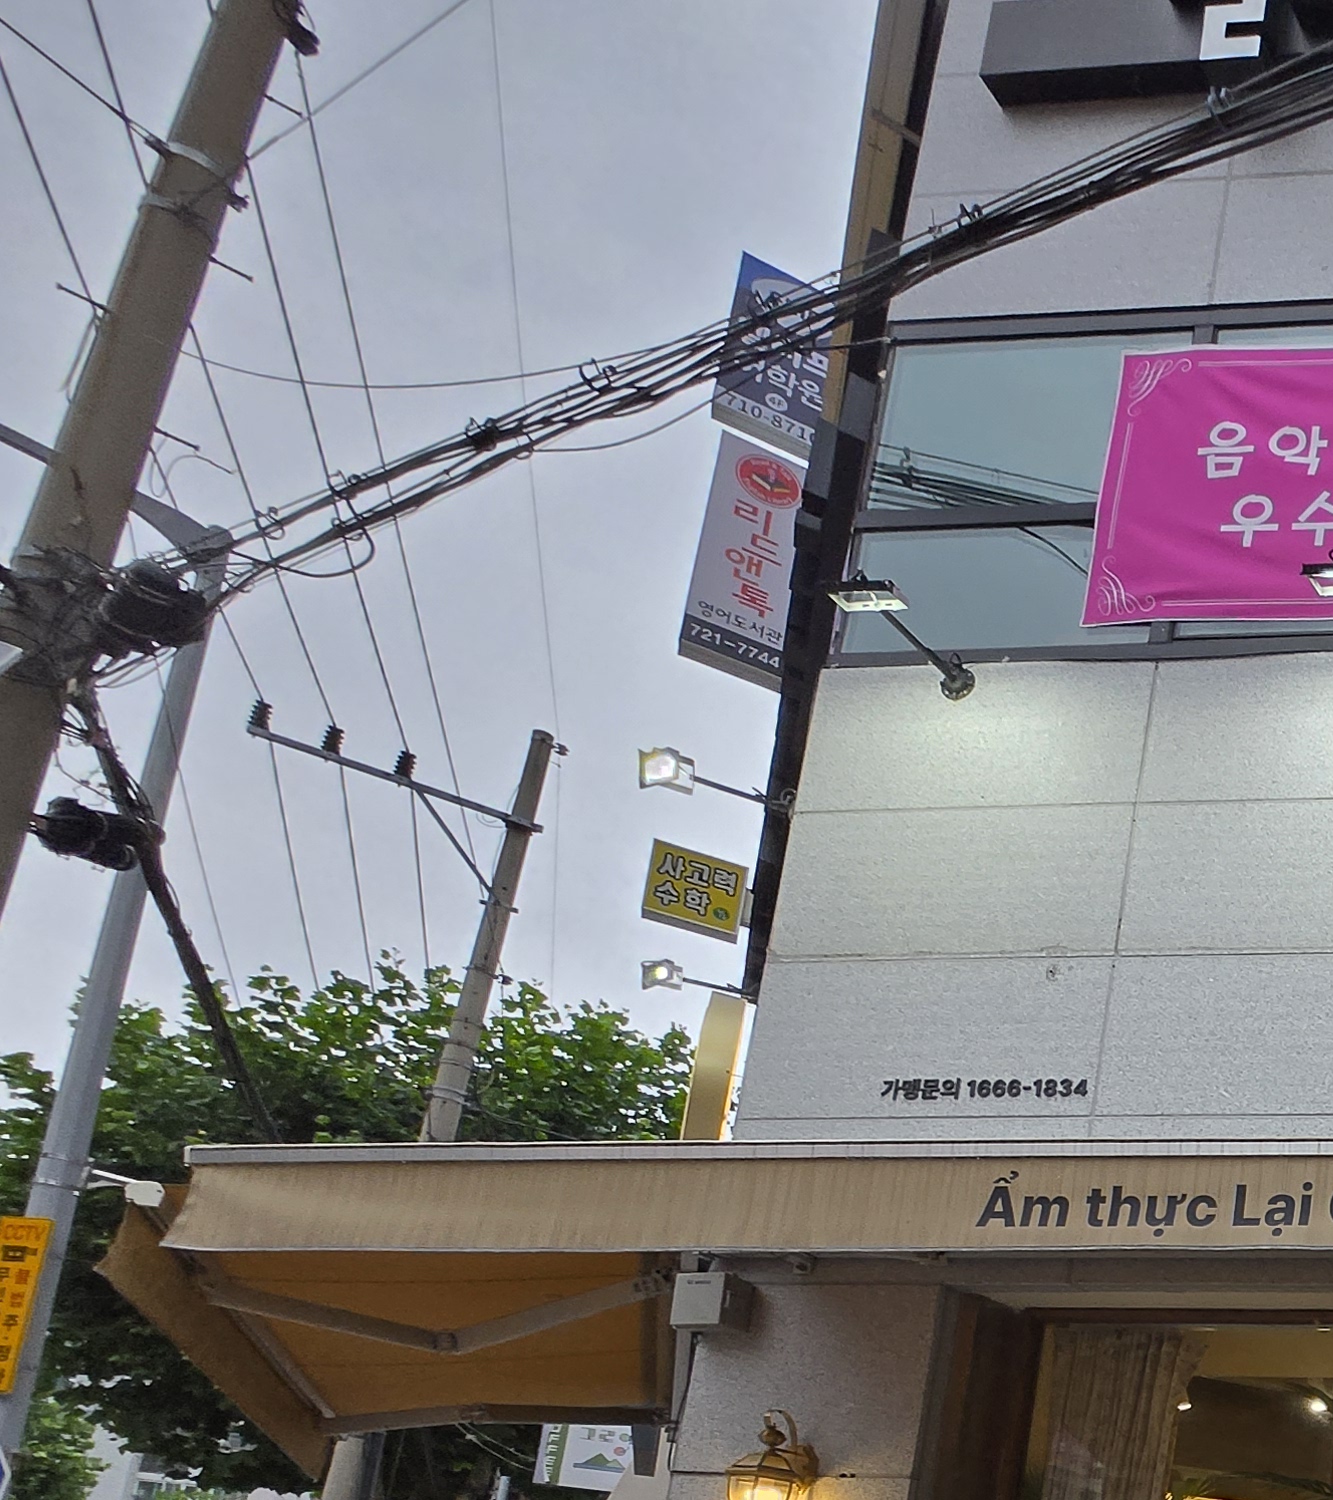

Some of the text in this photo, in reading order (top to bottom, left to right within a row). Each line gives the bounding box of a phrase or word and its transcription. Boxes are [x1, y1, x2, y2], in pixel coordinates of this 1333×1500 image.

[698, 600, 784, 646] 영어도서관
[689, 623, 780, 669] 721-7744
[657, 852, 739, 897] 사고력
[653, 880, 712, 917] 수학
[881, 1078, 1088, 1101] 가맹문의 1666-1834
[976, 1170, 1068, 1226] Ẩm
[1086, 1184, 1217, 1237] thực
[1232, 1182, 1313, 1237] Lại
